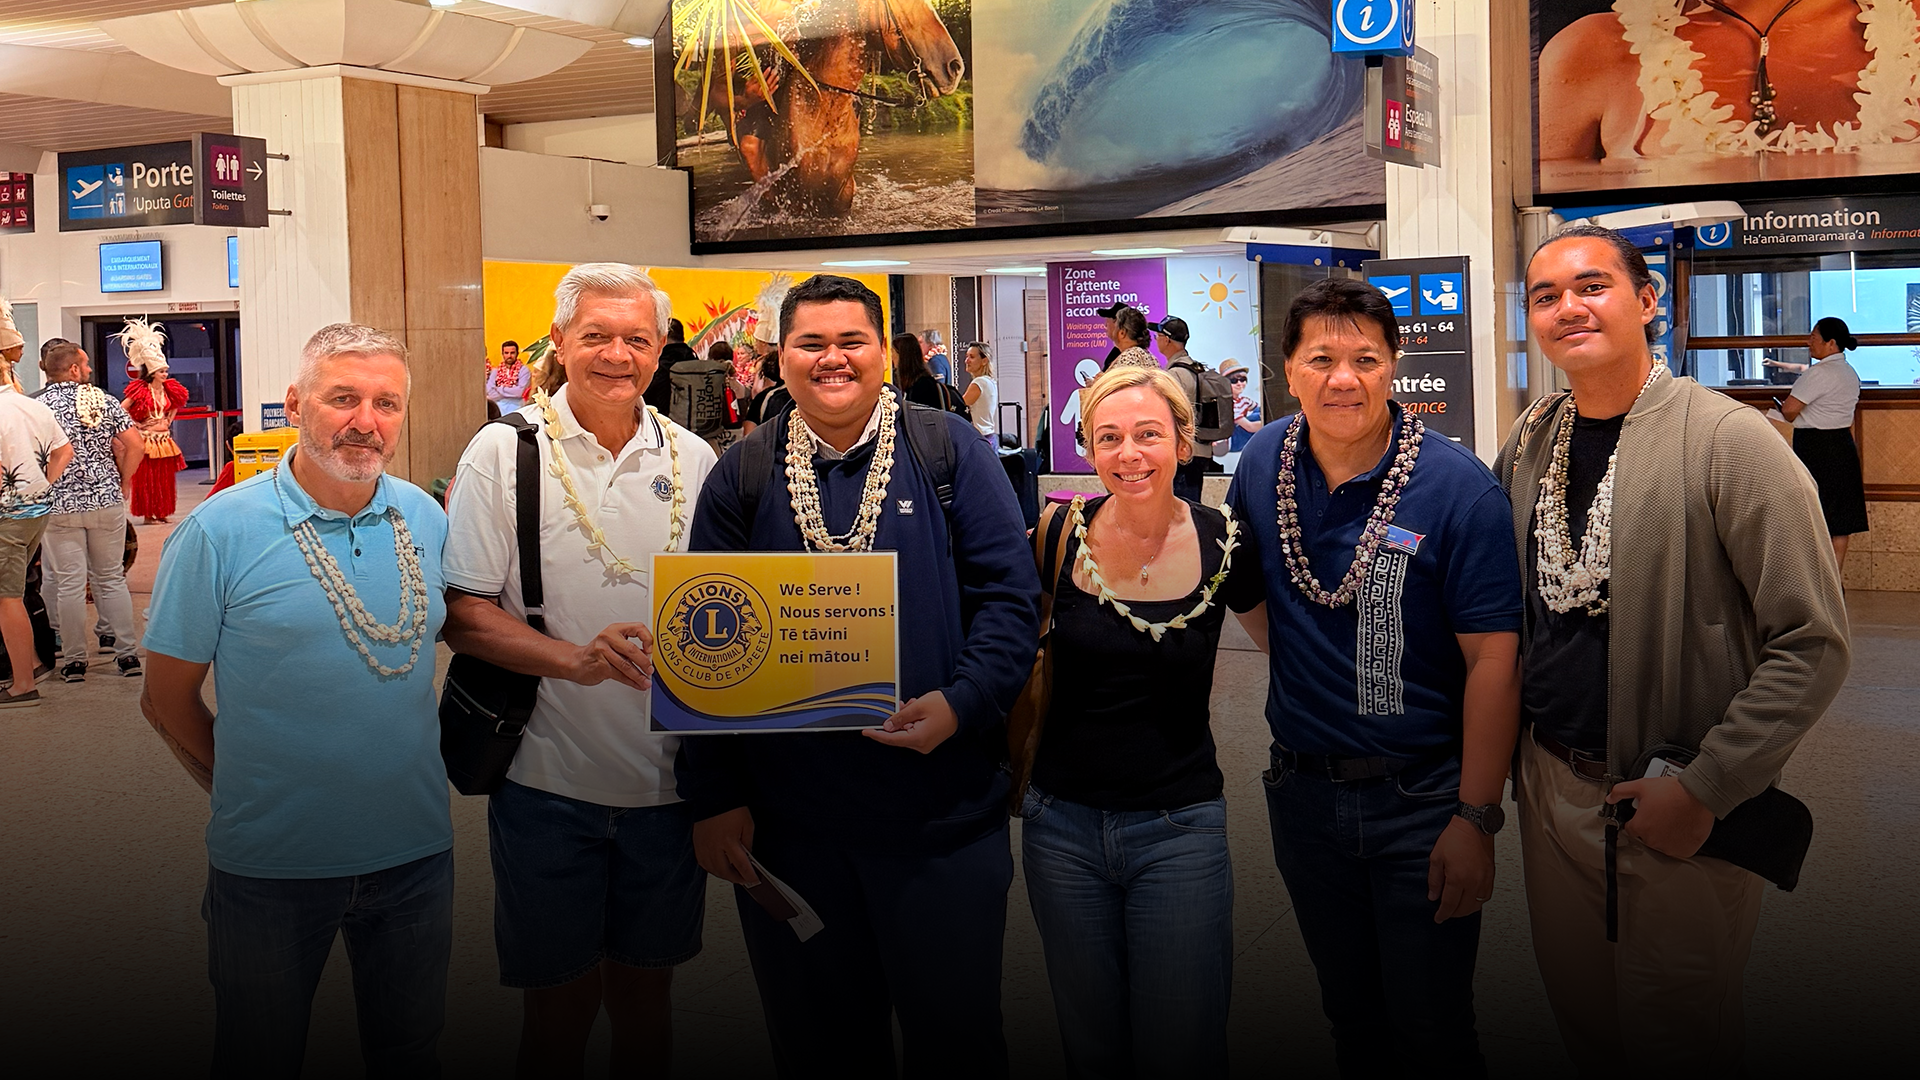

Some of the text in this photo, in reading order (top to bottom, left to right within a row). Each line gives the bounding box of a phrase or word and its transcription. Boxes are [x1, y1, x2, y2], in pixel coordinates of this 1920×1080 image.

[1406, 104, 1424, 128] Espace
[132, 162, 193, 188] Porte
[173, 194, 194, 208] Gat
[212, 189, 246, 201] Toilettes
[1743, 208, 1880, 231] Information
[1870, 228, 1920, 239] Informat
[1064, 268, 1096, 280] Zone
[1065, 280, 1120, 292] d'attente
[1066, 292, 1138, 304] Enfants non
[1066, 323, 1092, 331] Waiting
[1413, 322, 1428, 333] 61
[1438, 322, 1454, 332] 64
[1090, 340, 1107, 348] (UM)
[1416, 336, 1428, 344] 64
[1393, 373, 1446, 392] ntrée
[696, 388, 706, 418] FACE
[704, 376, 714, 418] NORTH
[688, 585, 742, 603] LIONS
[780, 583, 860, 596] We Serve !
[780, 604, 895, 618] Nous servons !
[704, 608, 728, 639] L
[779, 628, 847, 641] Tē tāvini
[660, 632, 769, 682] LIONS CLUB DE PAPEETE
[688, 648, 741, 663] INTERNATIONAL
[780, 649, 869, 663] nei mātou !
